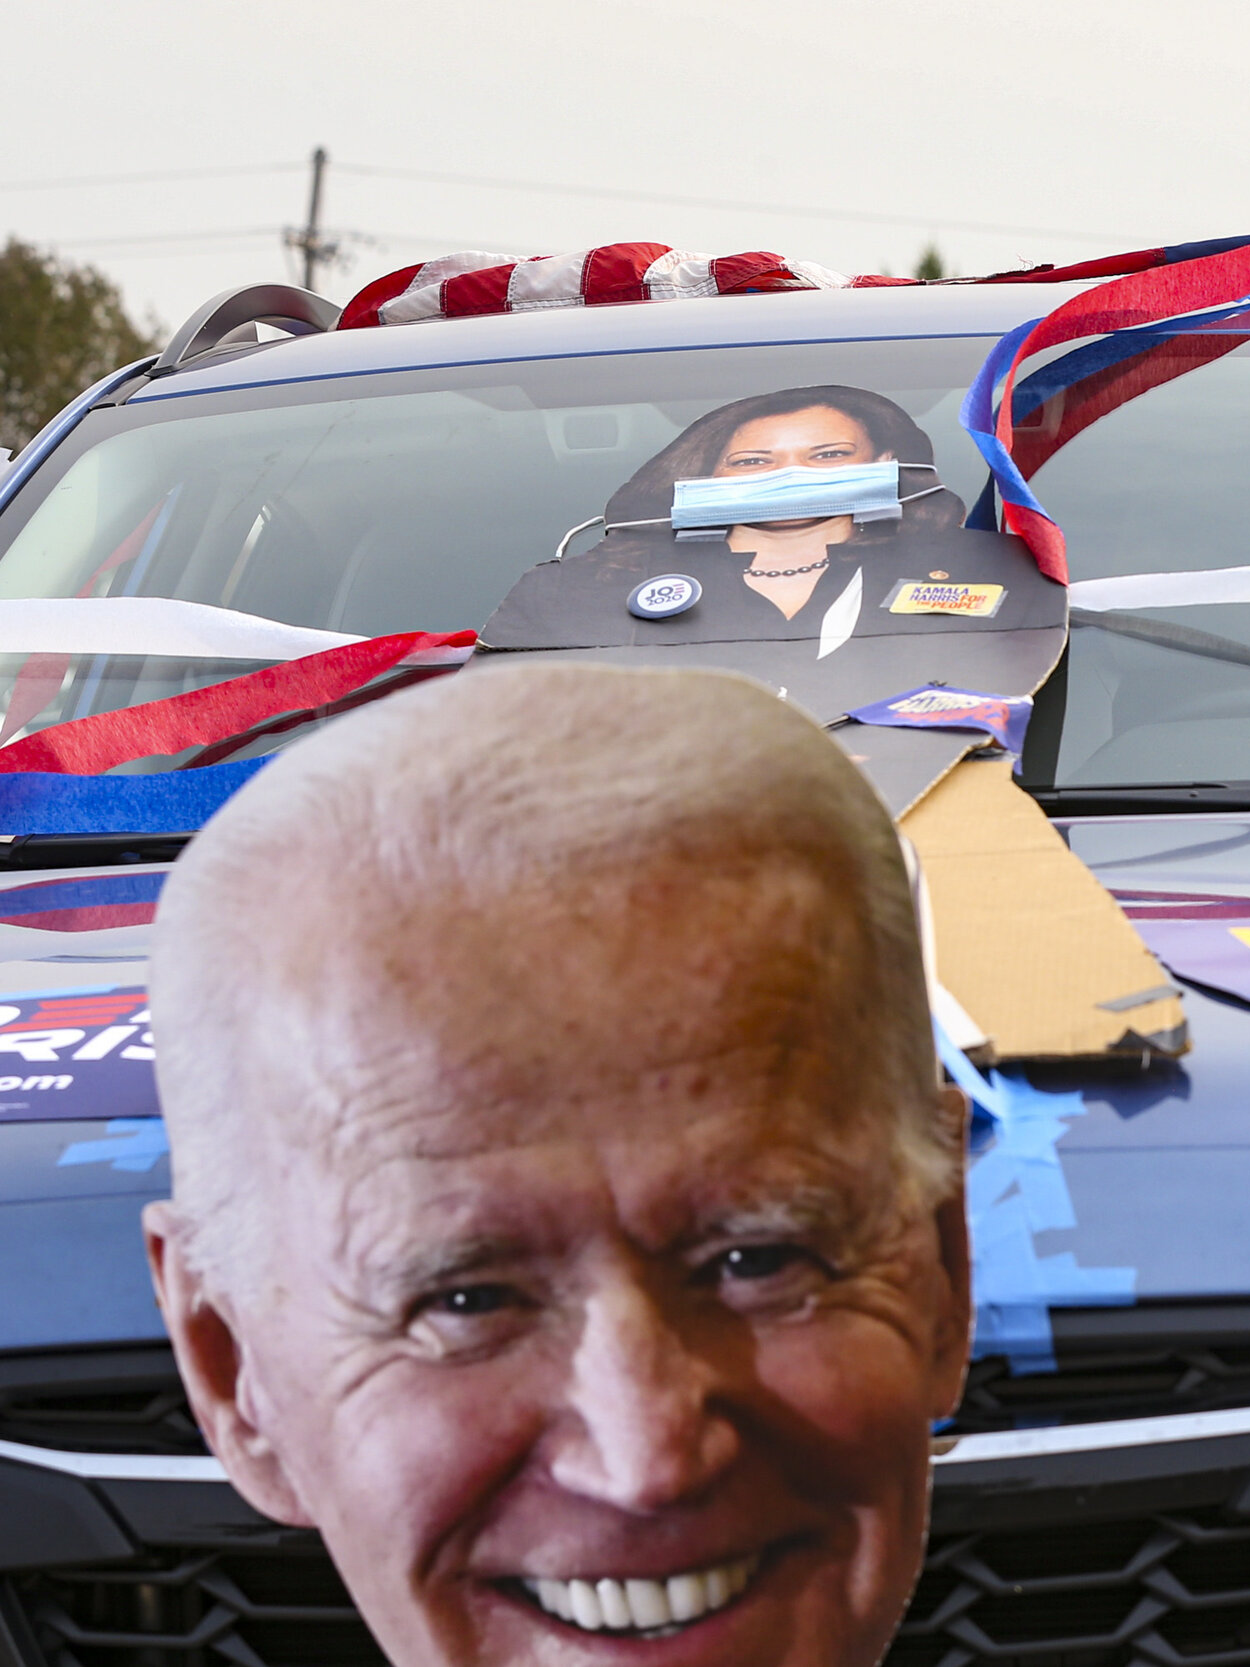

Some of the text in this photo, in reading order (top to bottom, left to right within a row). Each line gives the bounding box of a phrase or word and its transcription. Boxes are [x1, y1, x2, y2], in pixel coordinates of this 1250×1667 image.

[645, 583, 685, 601] JOE
[913, 587, 969, 595] KAMALA
[648, 594, 683, 606] 2020
[910, 594, 959, 602] HARRIS
[931, 601, 983, 610] PEOPLE
